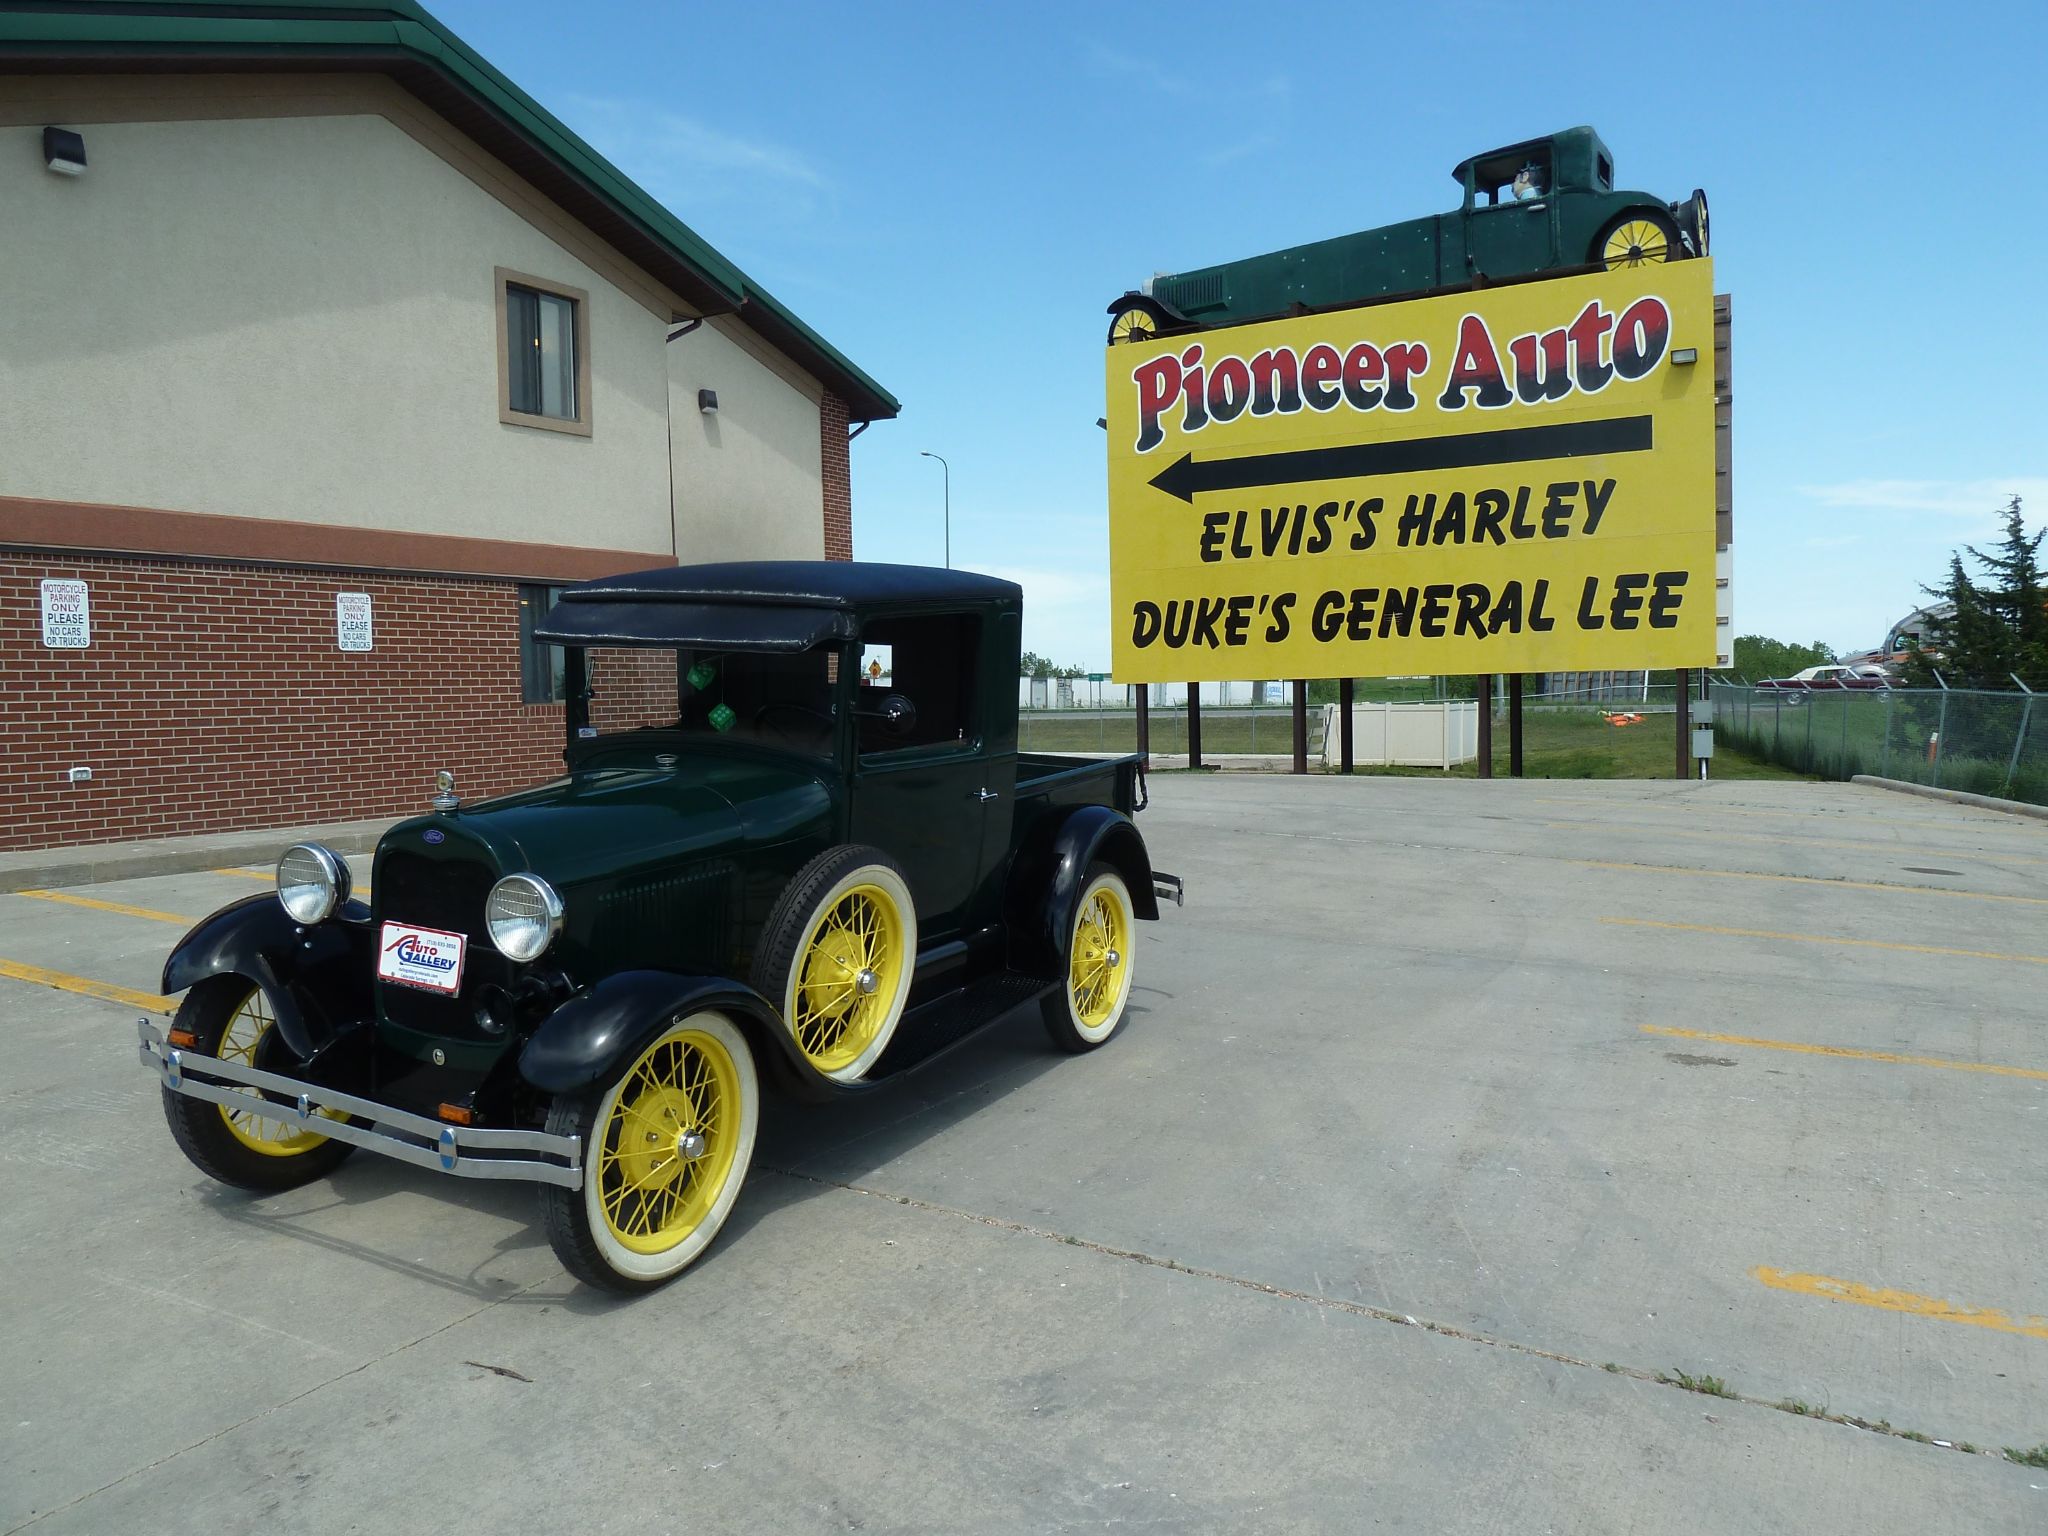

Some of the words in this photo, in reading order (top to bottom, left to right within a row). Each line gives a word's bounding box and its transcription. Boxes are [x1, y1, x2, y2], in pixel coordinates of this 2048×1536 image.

[1131, 341, 1431, 455] Pioneer
[1436, 295, 1673, 413] Auto
[1200, 498, 1384, 563] ELVIS'S
[1397, 479, 1617, 547] HARLEY
[43, 584, 86, 594] MOTORCYCLE
[50, 593, 81, 603] PARKING
[338, 596, 370, 605] MOTORCYCLE
[51, 603, 80, 612] ONLY
[343, 604, 366, 612] PARKING
[1132, 592, 1297, 651] DUKE'S
[1311, 579, 1555, 643] GENERAL
[1576, 571, 1689, 631] LEE
[47, 613, 84, 624] PLEASE
[344, 612, 365, 621] ONLY
[49, 626, 60, 636] NO
[61, 627, 82, 636] CARS
[341, 621, 369, 631] PLEASE
[46, 636, 57, 646] OR
[58, 637, 87, 646] TRUCKS
[343, 632, 351, 640] NO
[352, 632, 367, 641] CARS
[341, 641, 350, 649] OR
[350, 641, 371, 649] TRUCKS
[425, 831, 442, 841] Ford
[397, 940, 457, 970] GALLERY
